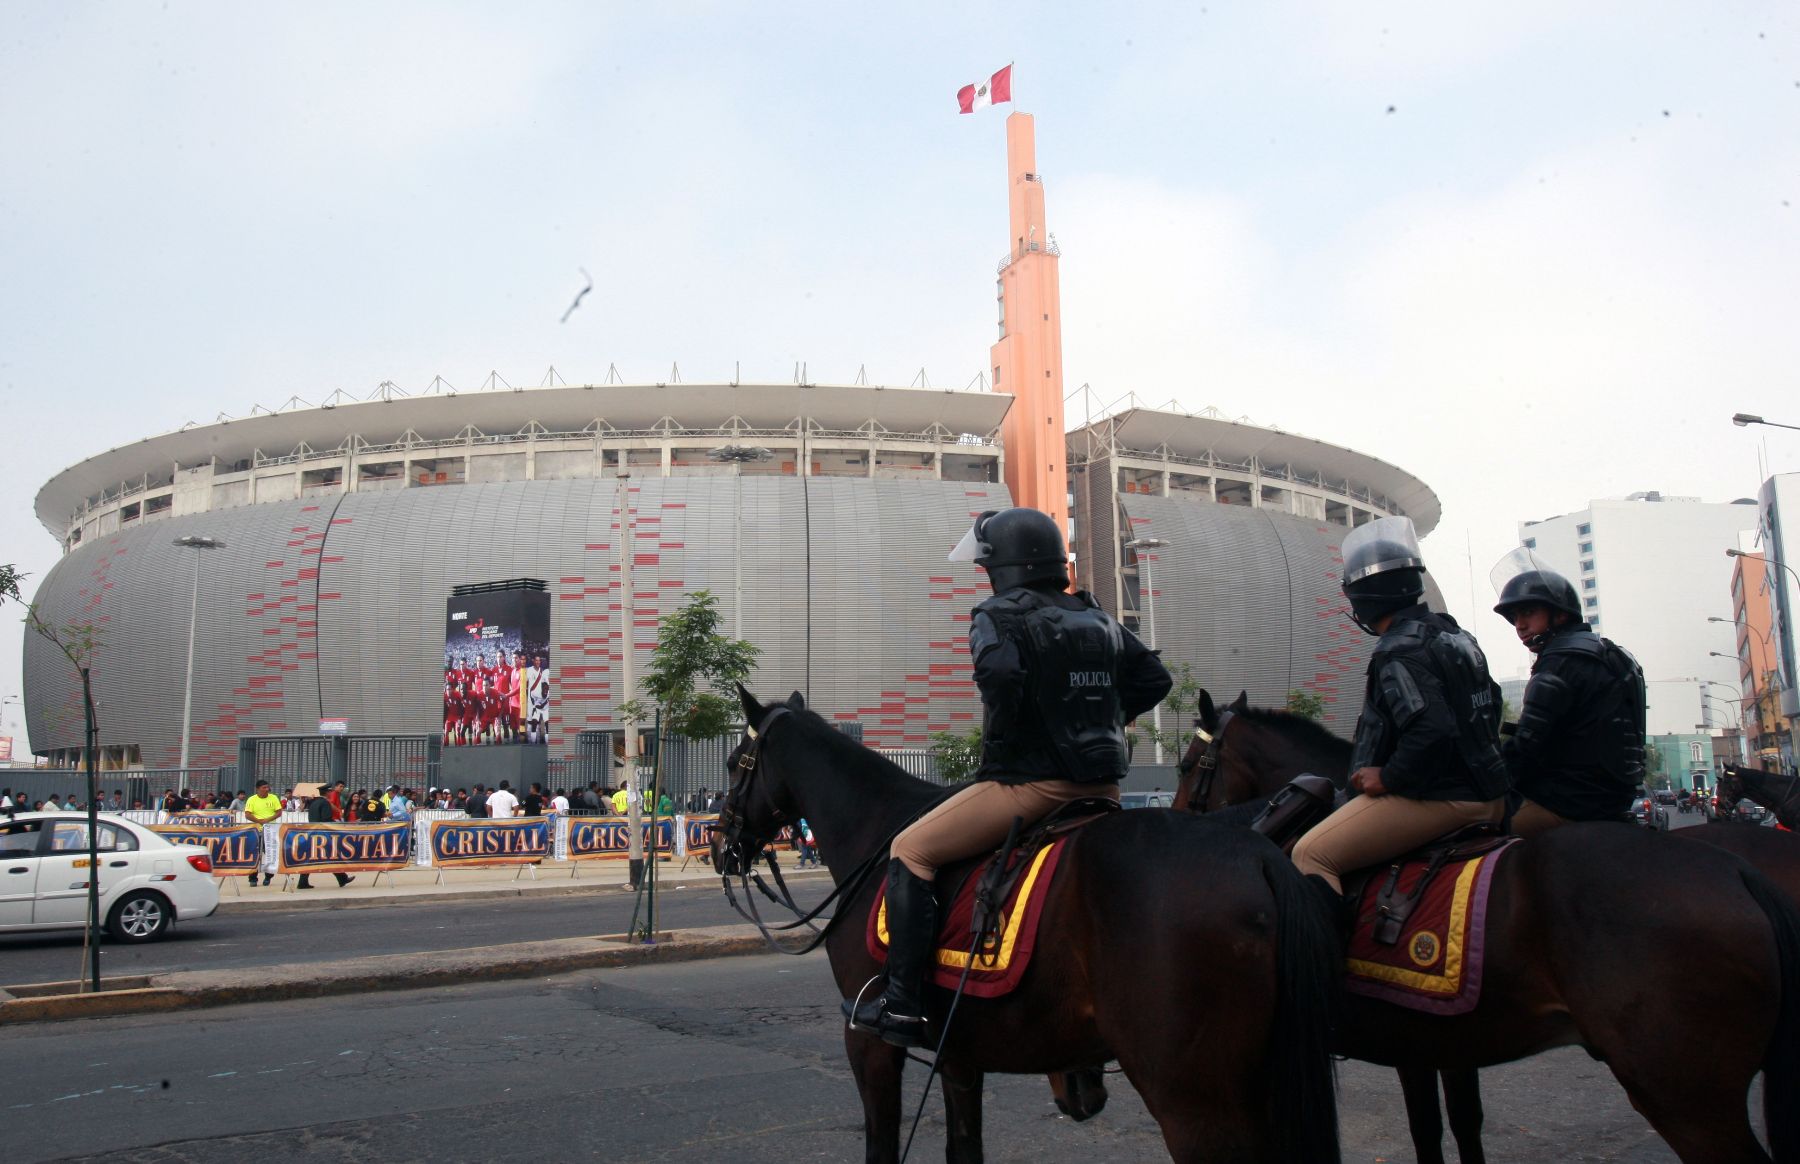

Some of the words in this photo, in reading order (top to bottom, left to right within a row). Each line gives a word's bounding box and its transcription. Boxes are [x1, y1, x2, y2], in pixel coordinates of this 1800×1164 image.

[1070, 671, 1112, 687] POLICIA
[291, 832, 405, 862] CRISTAL
[440, 828, 545, 856] CRISTAL
[576, 824, 669, 851] CRISAL
